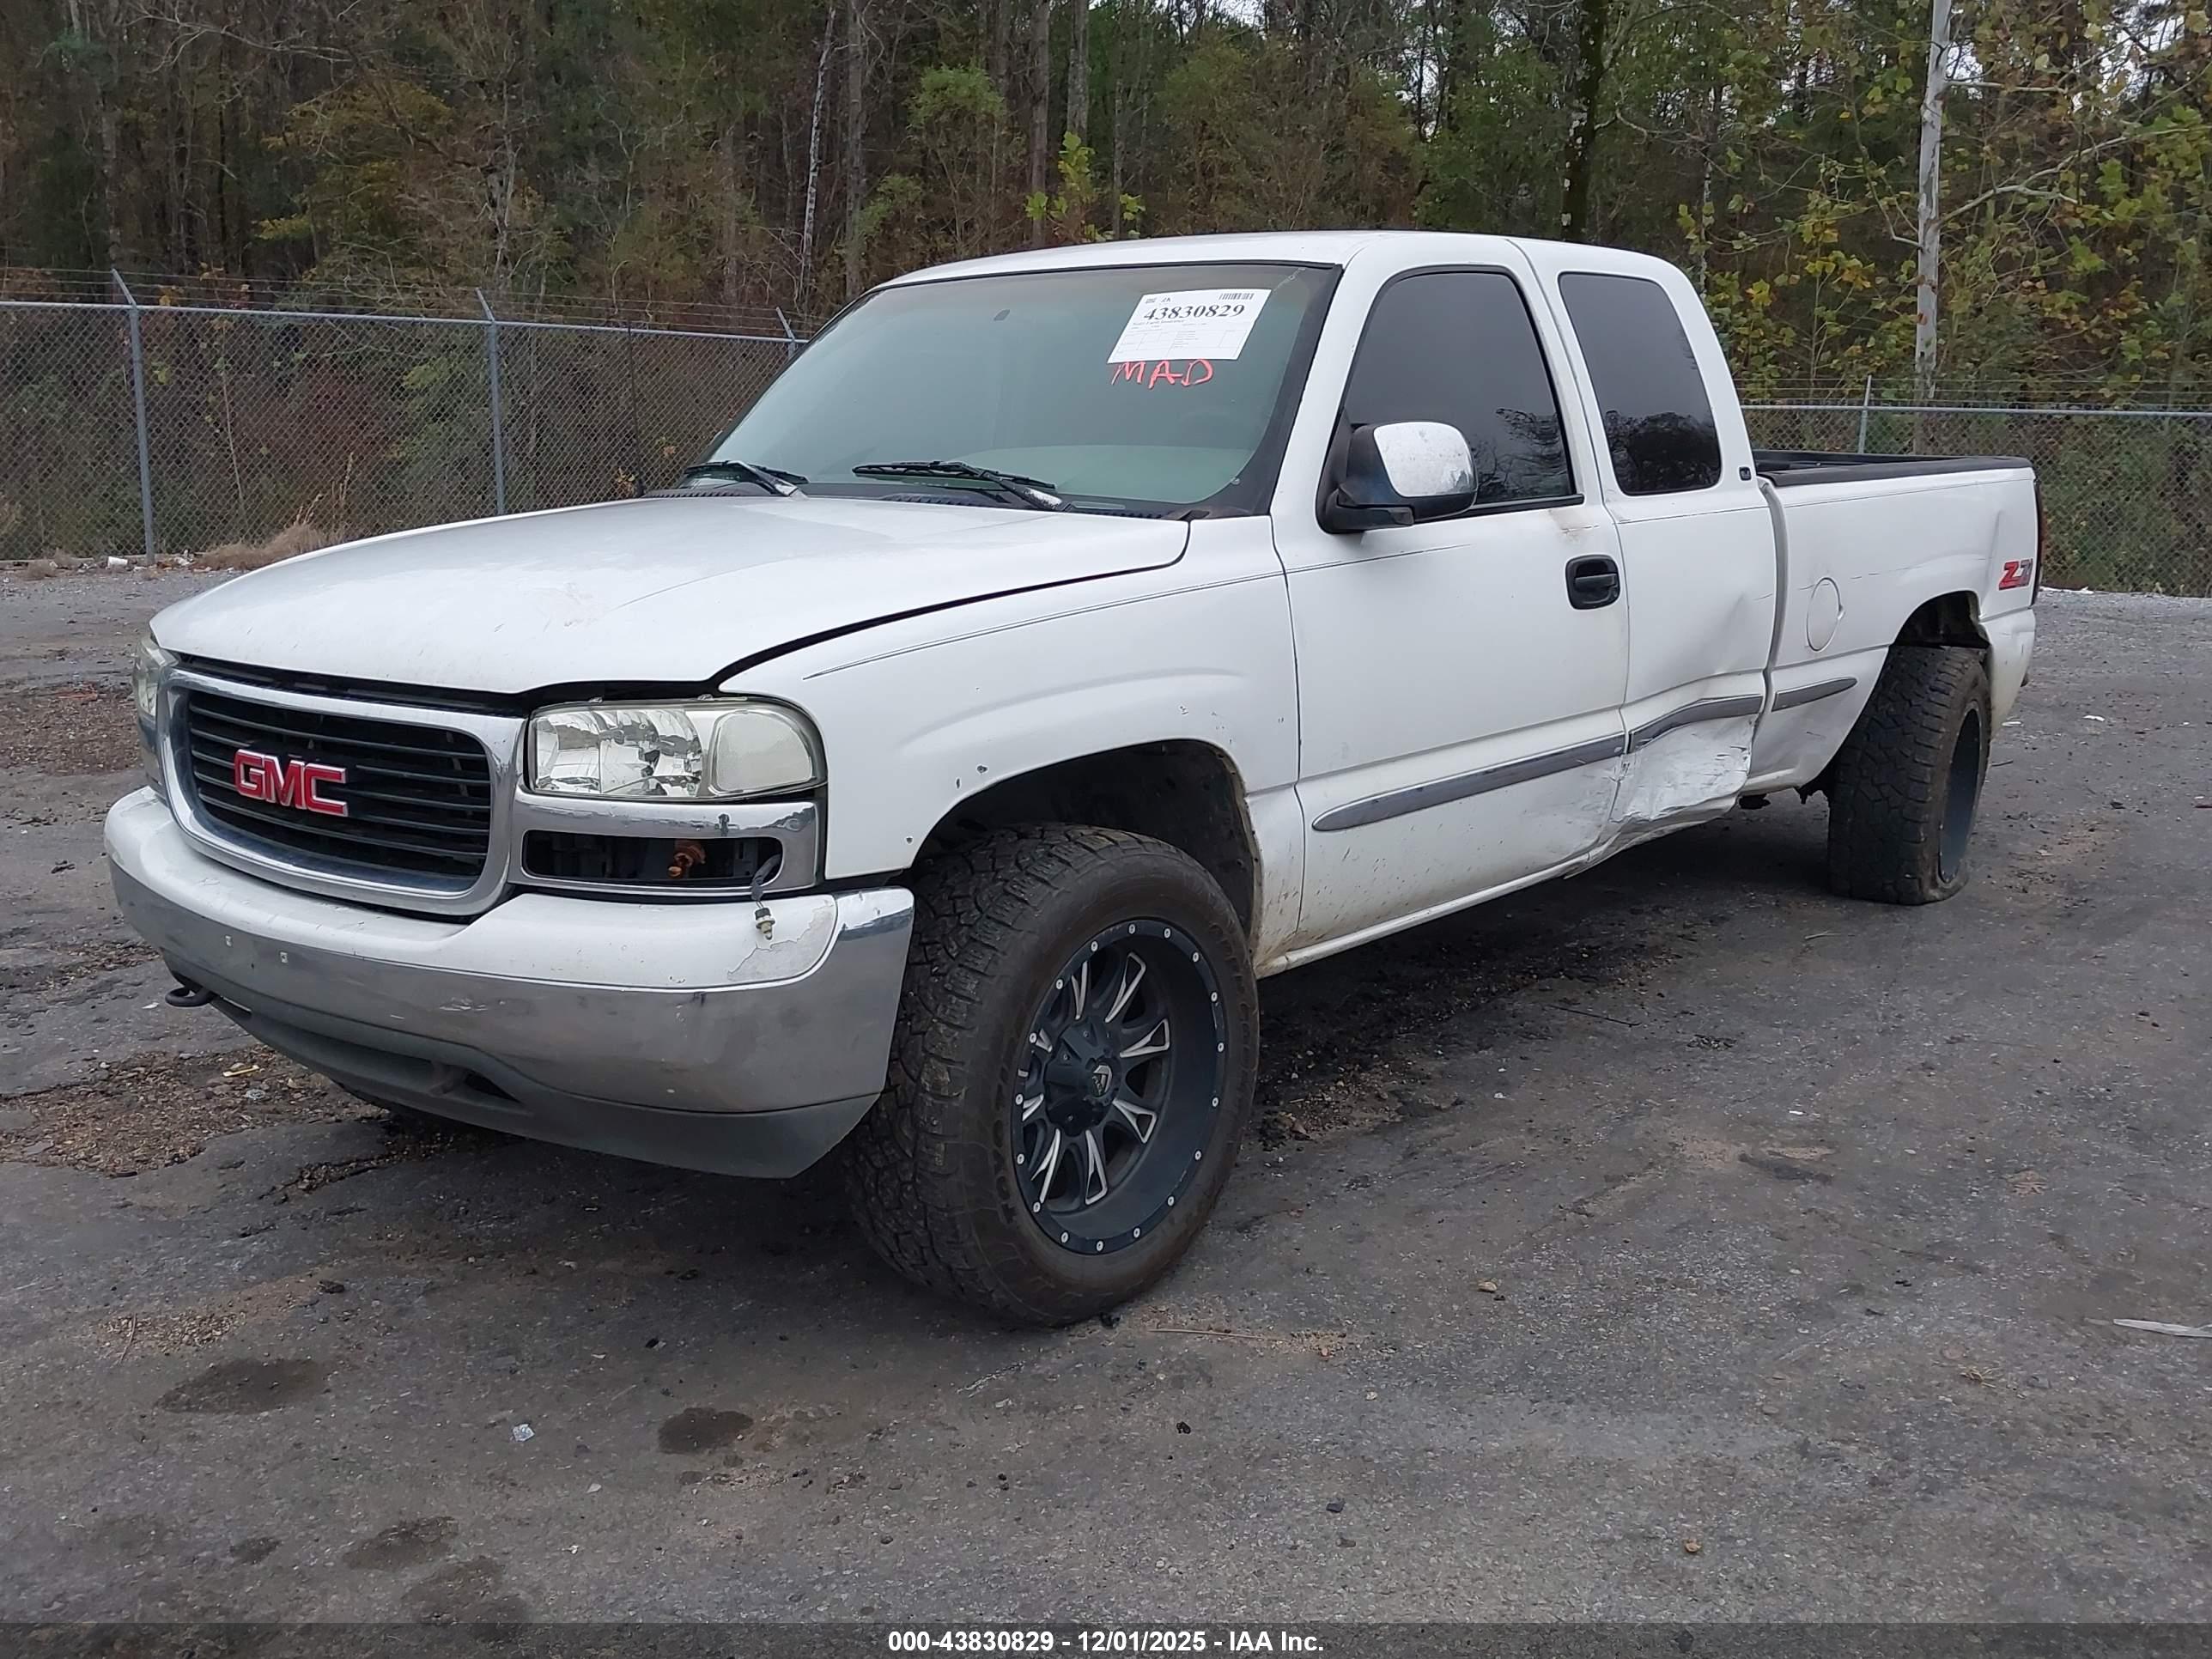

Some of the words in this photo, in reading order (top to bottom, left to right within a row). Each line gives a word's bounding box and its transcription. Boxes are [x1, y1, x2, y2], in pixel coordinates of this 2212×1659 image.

[1143, 304, 1245, 320] 43830829
[1110, 358, 1214, 389] MAD
[234, 749, 349, 817] GMC
